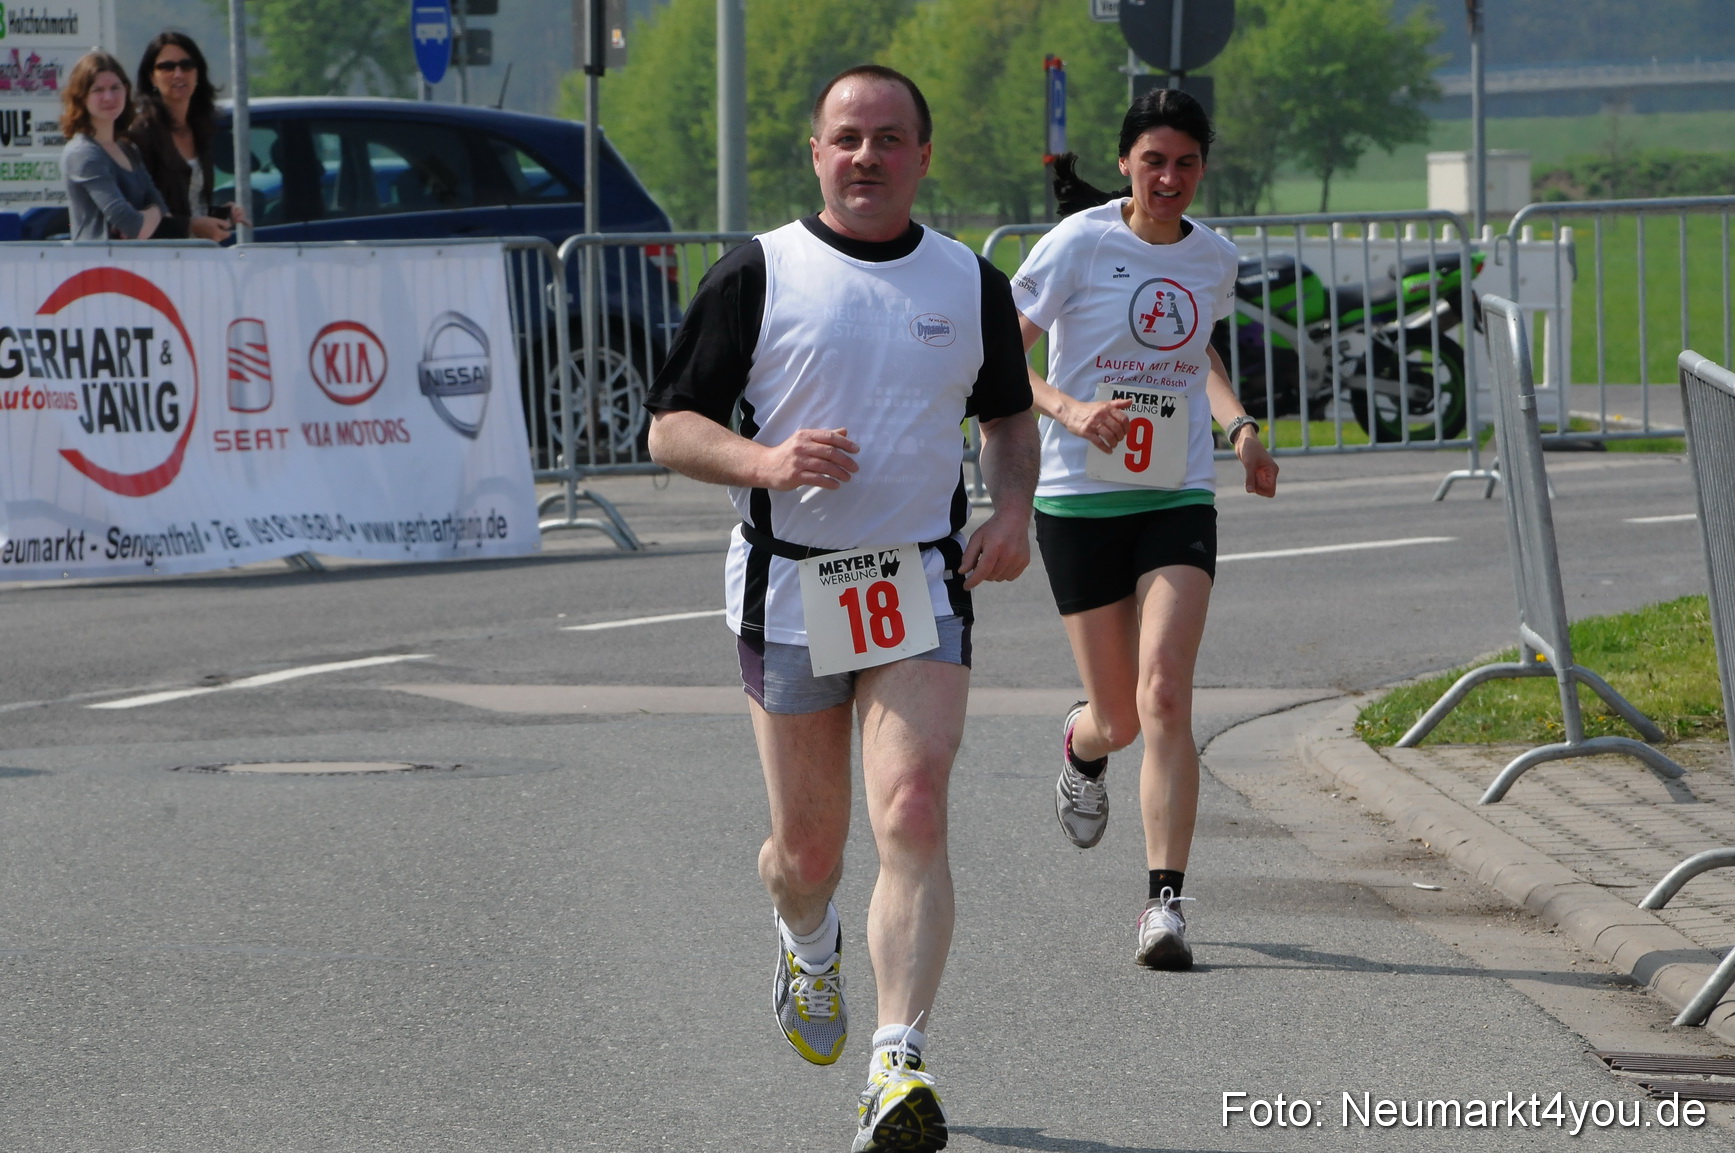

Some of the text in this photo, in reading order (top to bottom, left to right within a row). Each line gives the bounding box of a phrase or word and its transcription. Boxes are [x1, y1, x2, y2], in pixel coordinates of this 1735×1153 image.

[917, 322, 950, 340] Dynamics
[0, 326, 172, 379] GERHART &
[321, 342, 374, 385] KIA
[1095, 355, 1145, 371] LAUFEN
[1174, 360, 1199, 375] HERZ
[1160, 377, 1187, 387] Röschl
[0, 384, 78, 410] utohaus
[79, 381, 179, 433] JÄNIG
[213, 428, 289, 451] SEAT
[302, 418, 411, 447] KIA MOTORS
[1124, 417, 1154, 473] 9
[105, 521, 206, 566] Sengenthal
[818, 554, 876, 577] MEYER
[819, 568, 878, 587] WERBUNG
[838, 580, 906, 655] 18
